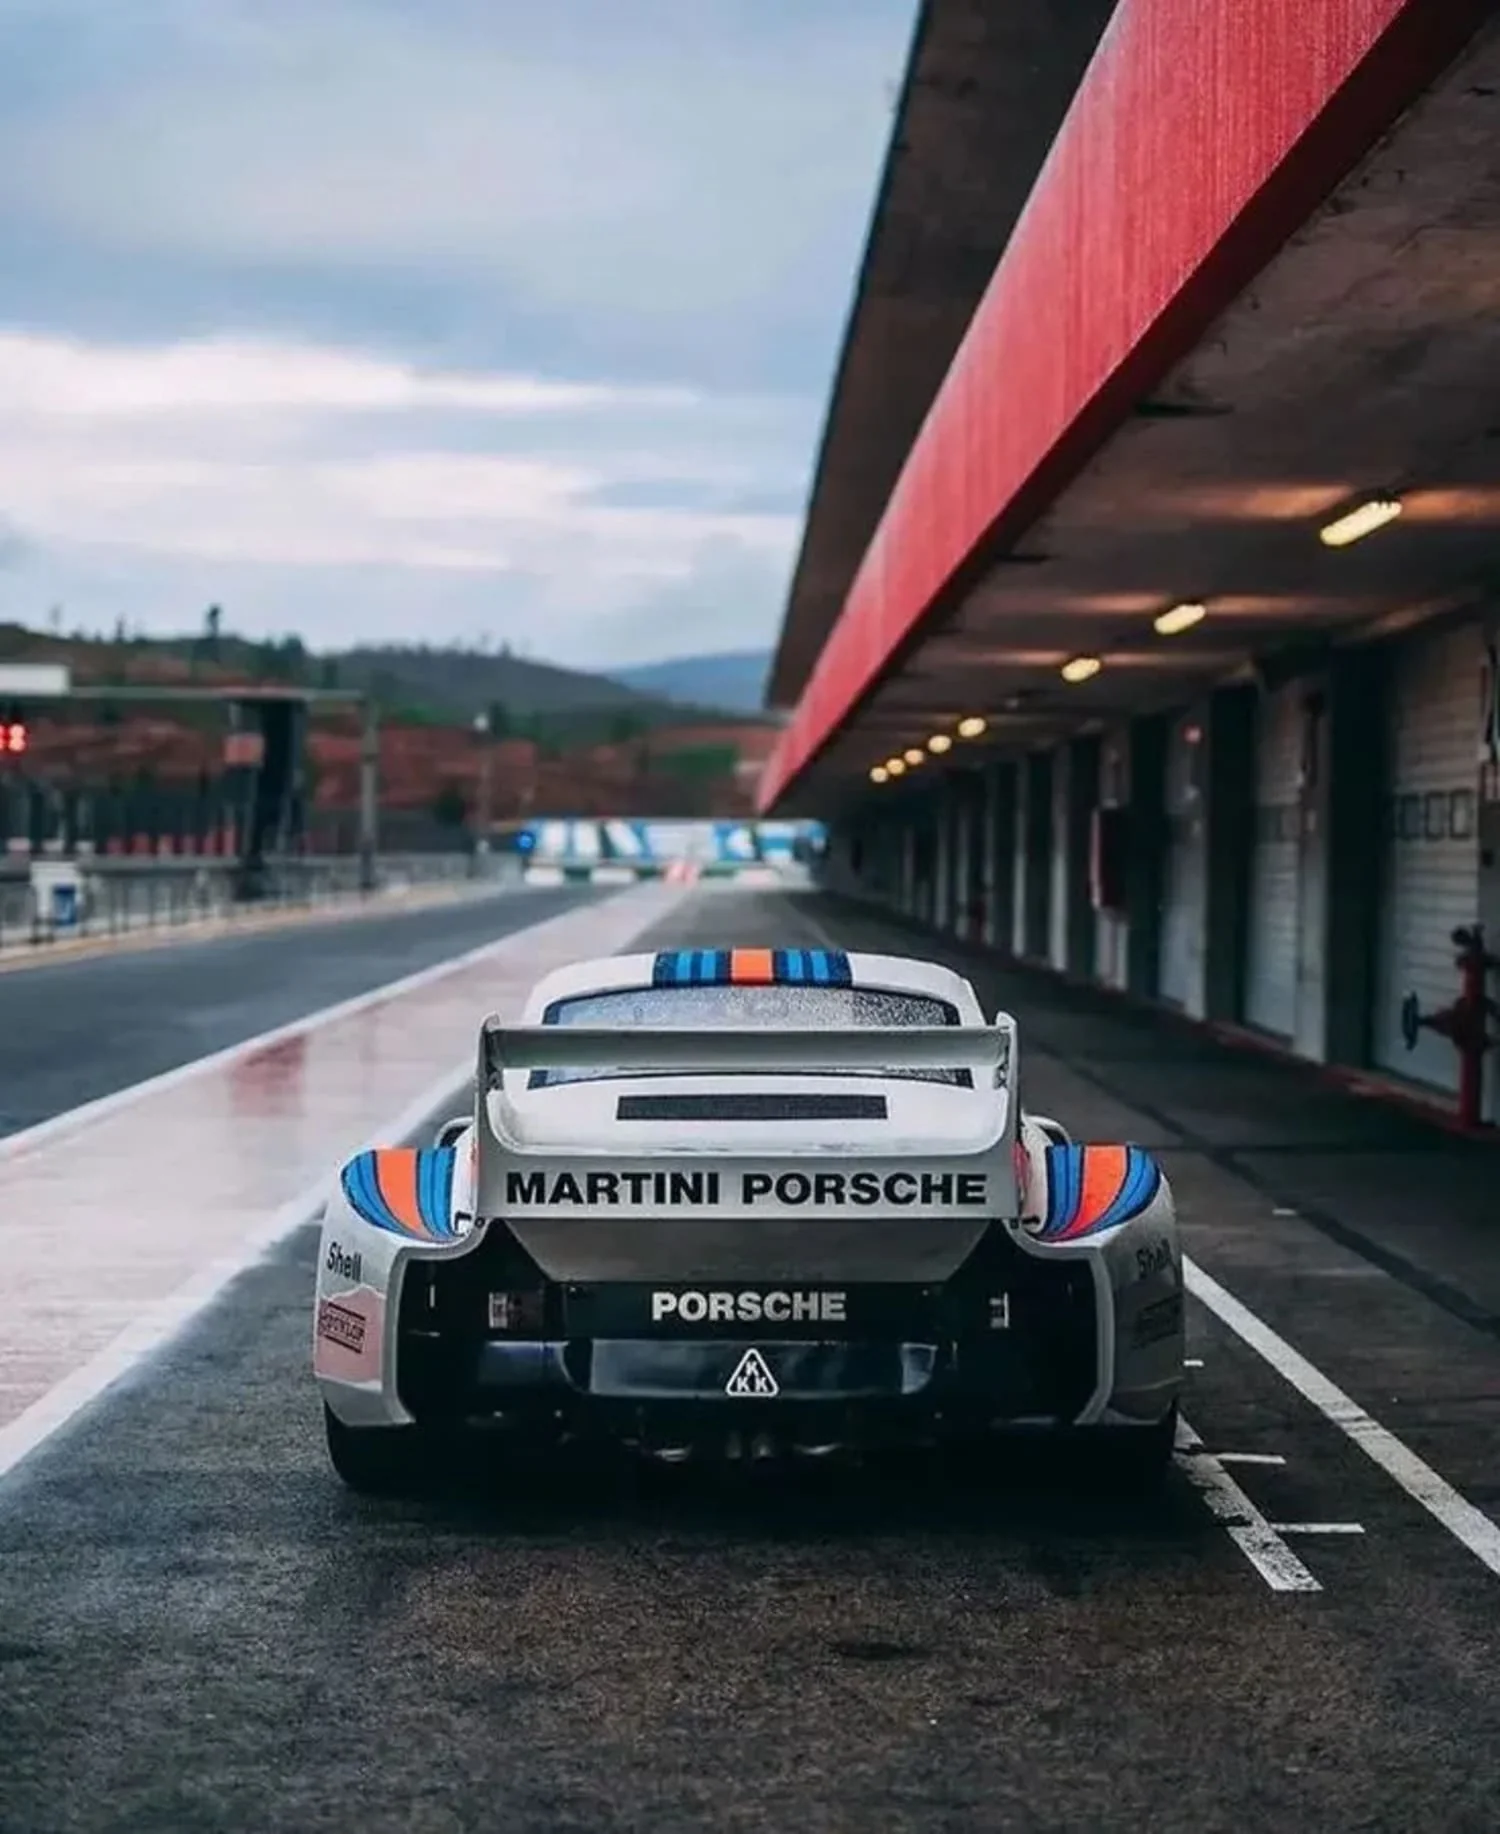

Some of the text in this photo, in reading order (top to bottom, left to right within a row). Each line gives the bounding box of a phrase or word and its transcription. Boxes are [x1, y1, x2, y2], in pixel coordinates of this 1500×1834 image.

[506, 1171, 988, 1205] MARTINI PORSCHE
[327, 1240, 362, 1283] Shell
[651, 1291, 847, 1322] PORSCHE
